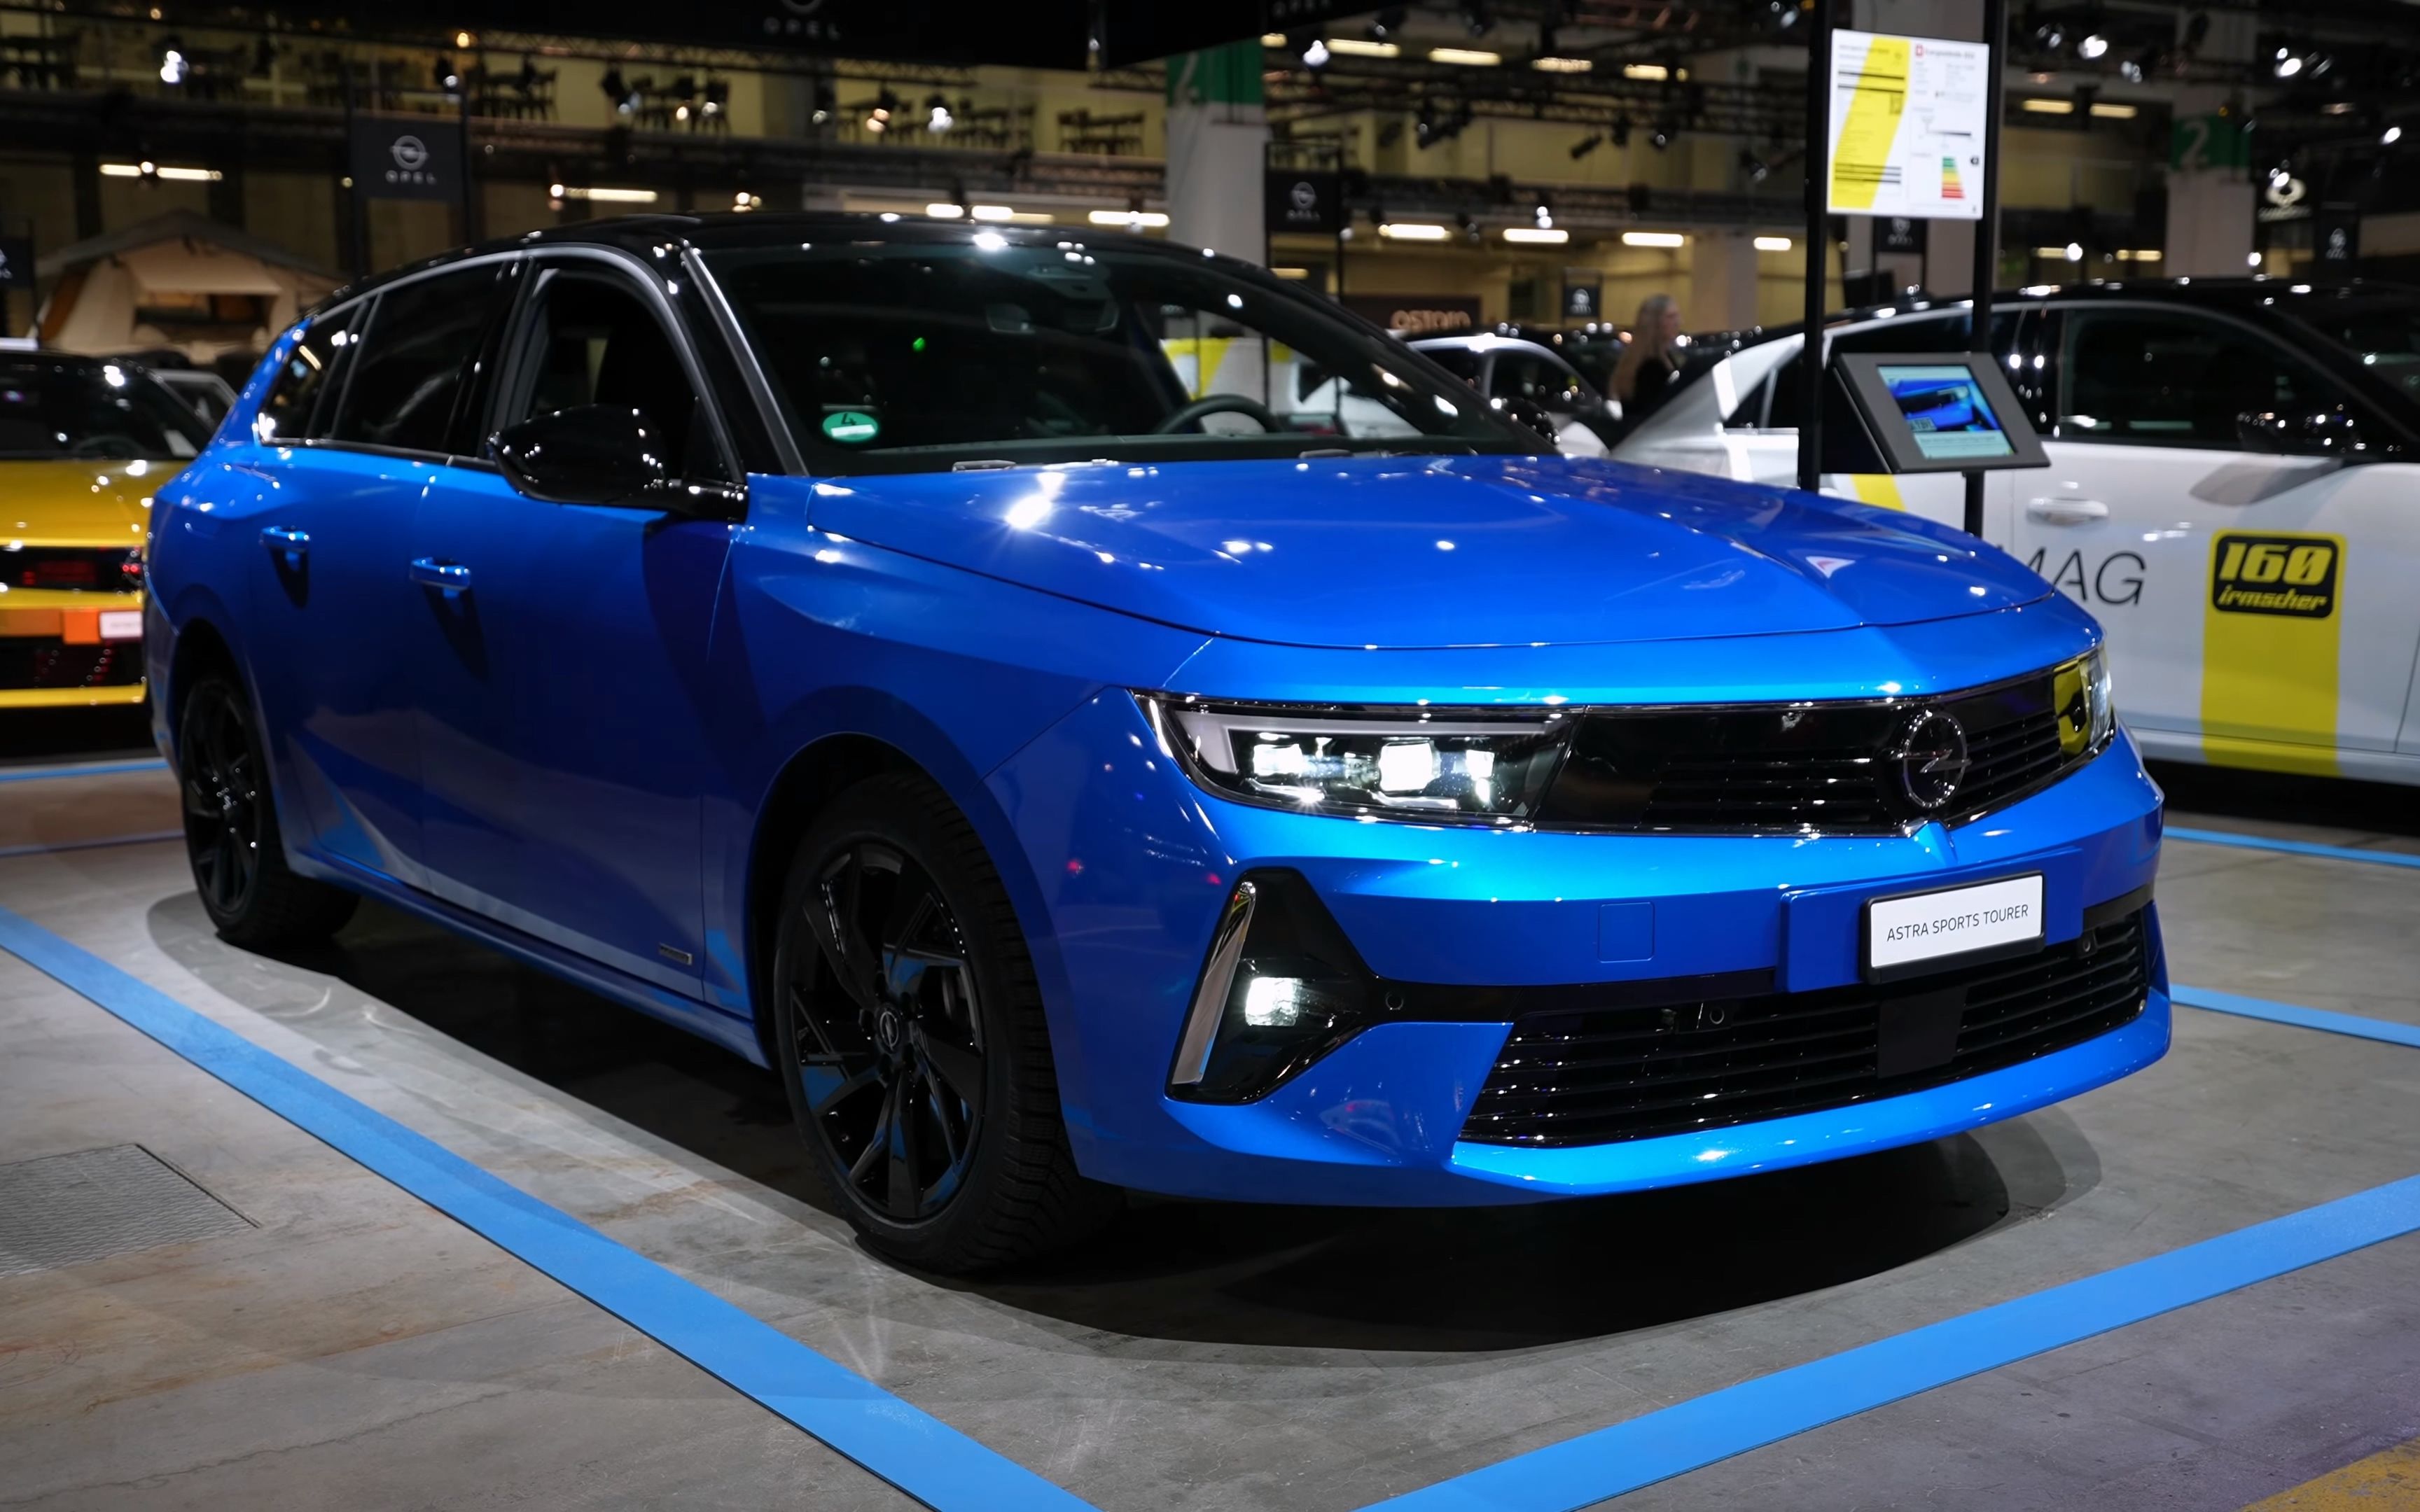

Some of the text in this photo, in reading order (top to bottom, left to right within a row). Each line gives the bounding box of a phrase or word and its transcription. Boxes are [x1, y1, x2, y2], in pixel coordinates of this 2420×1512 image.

[2179, 120, 2210, 169] 2
[2218, 542, 2333, 586] 160
[1886, 903, 2029, 942] ASTRA SPORTS TOURER
